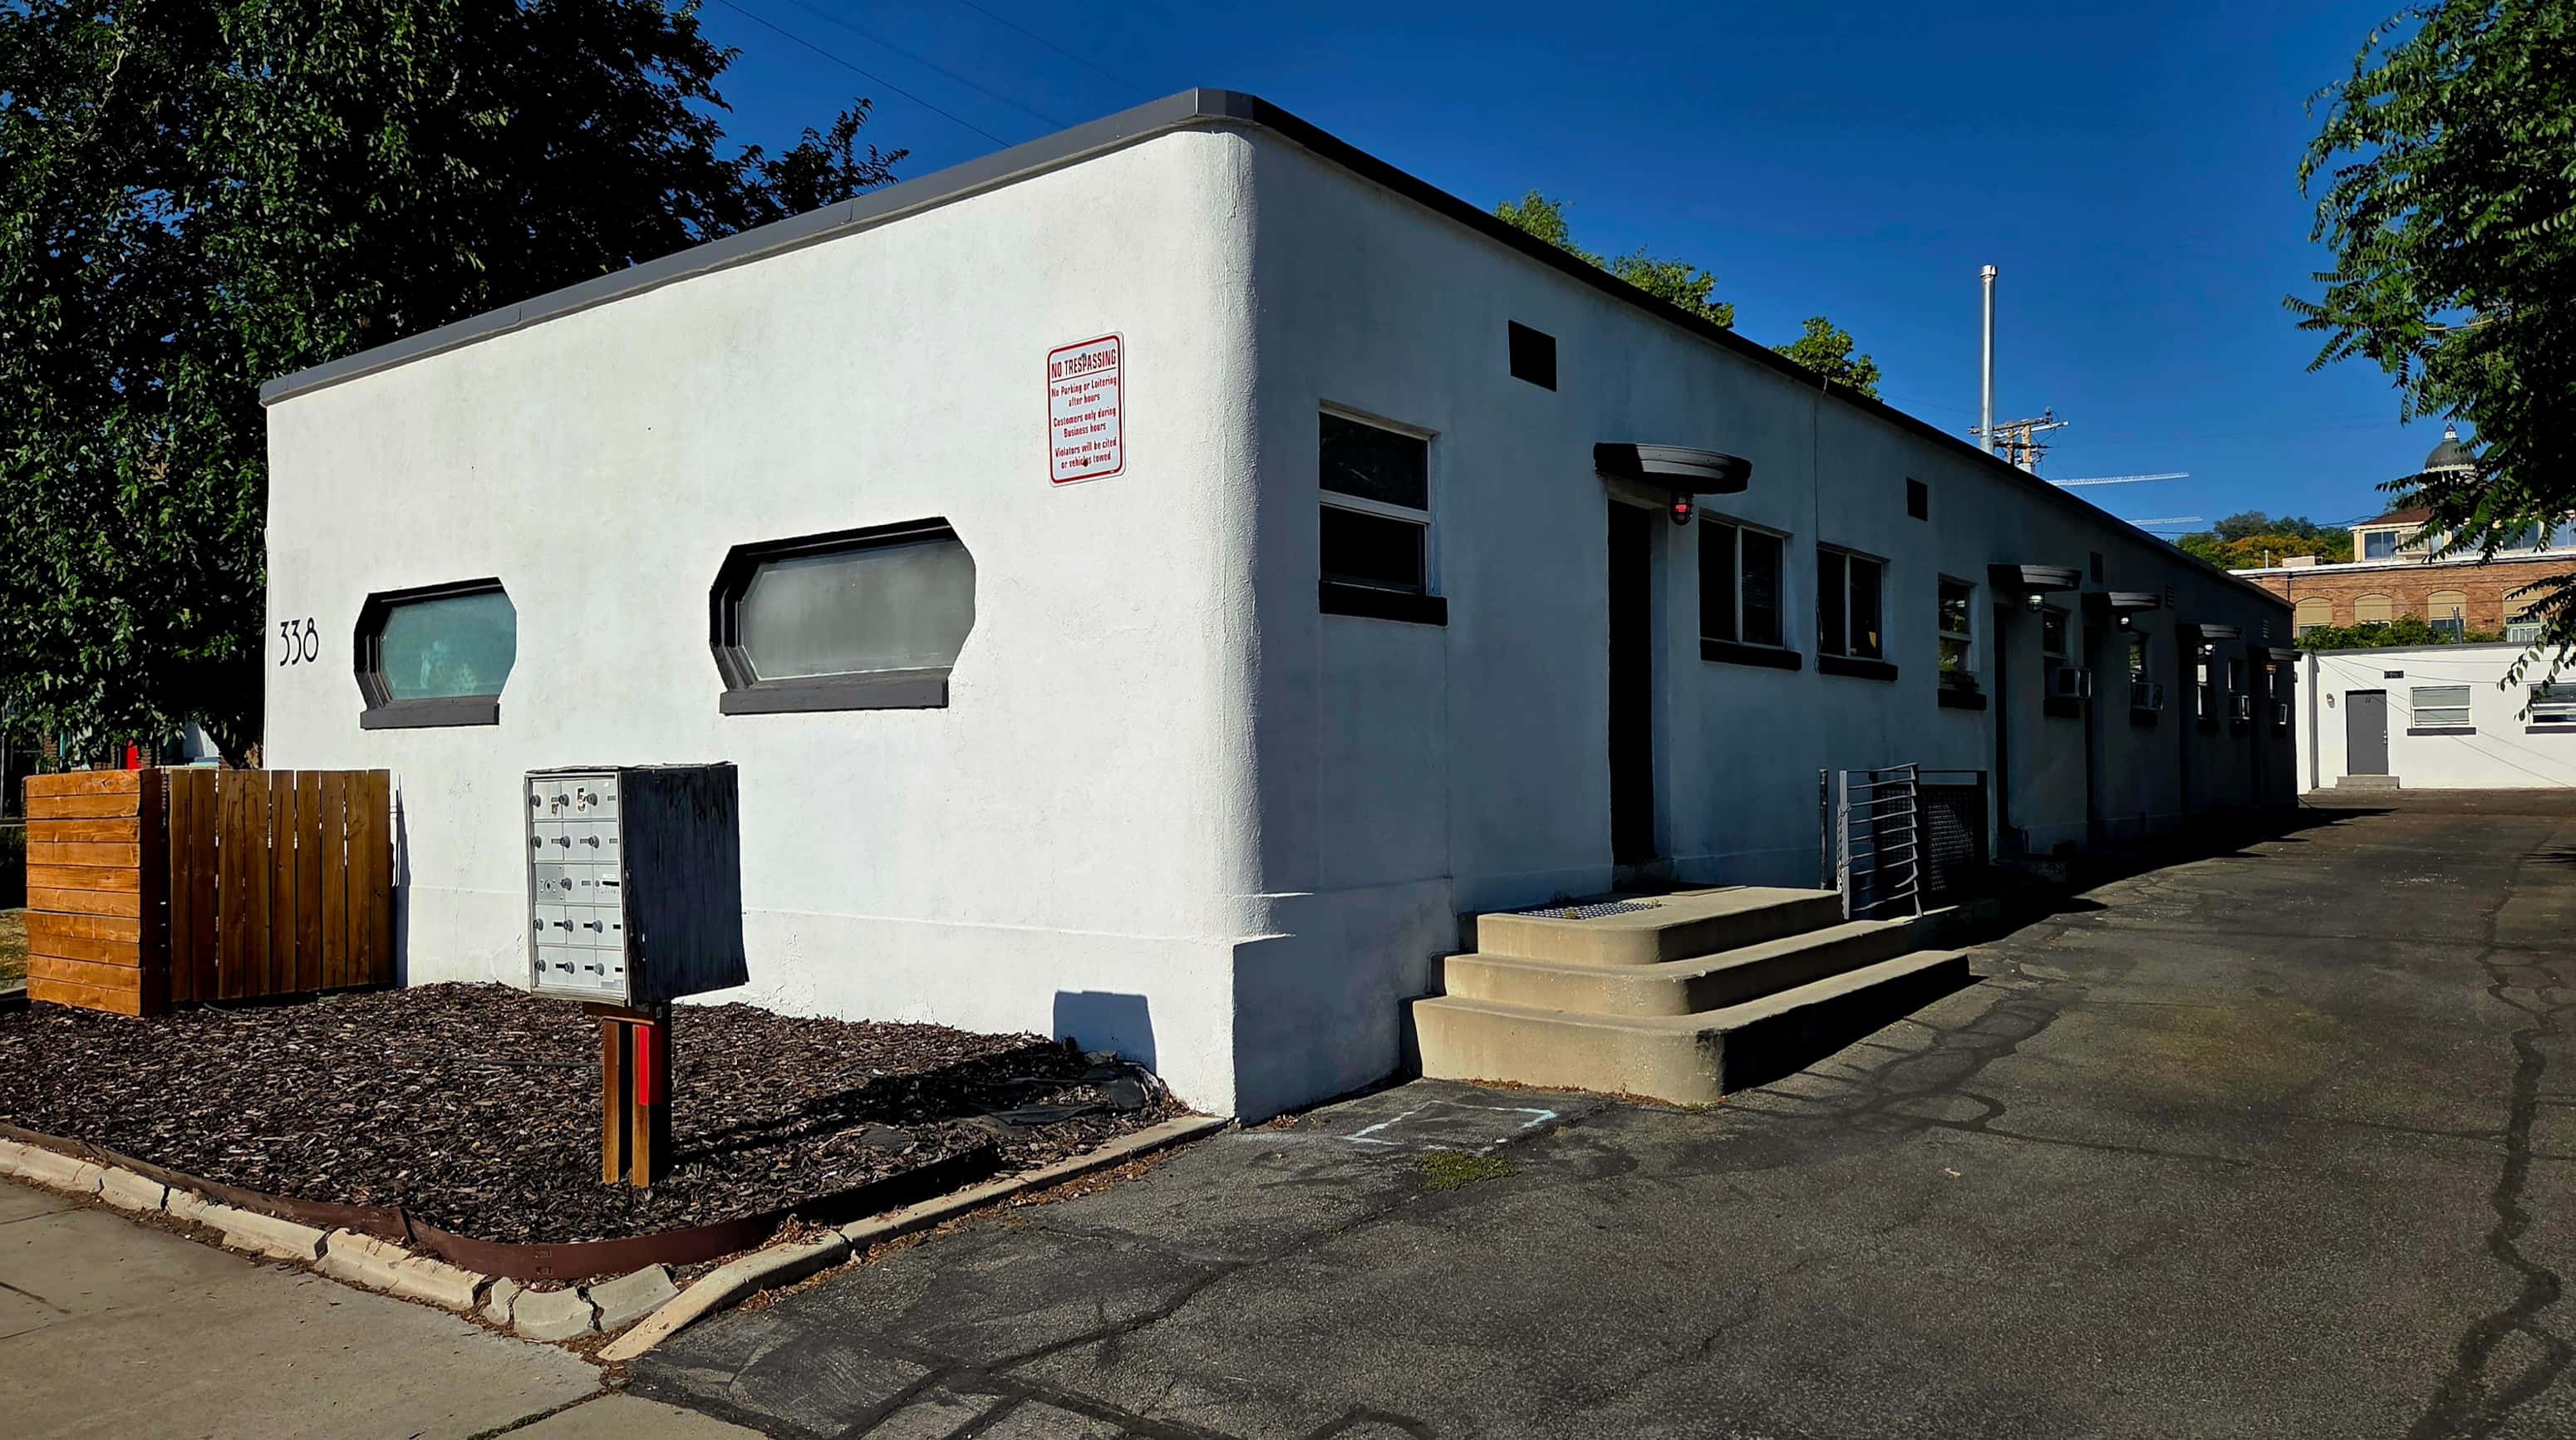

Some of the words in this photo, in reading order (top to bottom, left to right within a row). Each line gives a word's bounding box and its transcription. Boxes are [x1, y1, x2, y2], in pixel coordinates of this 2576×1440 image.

[1051, 361, 1062, 379] NO
[1064, 349, 1116, 376] TRESPASSING
[1051, 388, 1059, 397] No
[1061, 383, 1082, 396] Parking
[1091, 375, 1117, 389] Loitering
[1069, 396, 1083, 407] after
[1084, 393, 1100, 403] hours
[1054, 414, 1083, 427] Customers
[1084, 410, 1096, 421] only
[1098, 406, 1116, 418] during
[1064, 426, 1089, 438] Business
[1090, 422, 1106, 432] hours
[1055, 446, 1080, 457] Violators
[1082, 441, 1092, 452] will
[1094, 440, 1101, 450] be
[1102, 436, 1117, 449] cited
[1061, 461, 1068, 469] or
[1094, 450, 1111, 463] towed
[279, 617, 319, 666] 338
